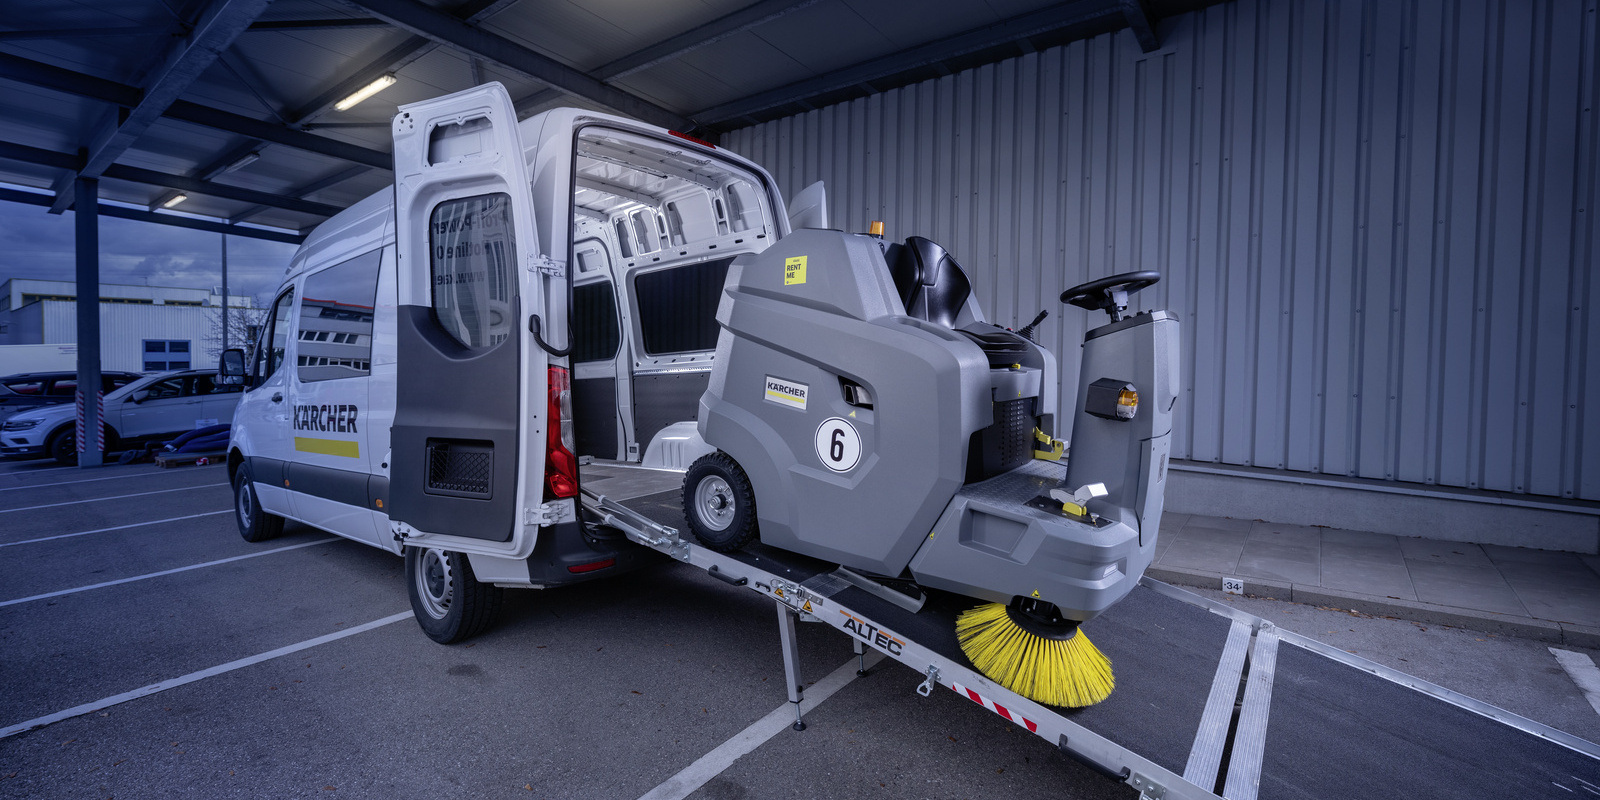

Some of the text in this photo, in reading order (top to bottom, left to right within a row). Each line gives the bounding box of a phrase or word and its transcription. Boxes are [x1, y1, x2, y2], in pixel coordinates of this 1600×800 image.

[767, 381, 806, 398] KÄRCHER
[293, 404, 359, 433] KÄRCHER
[830, 428, 845, 462] 6
[843, 618, 902, 656] ALTEC
